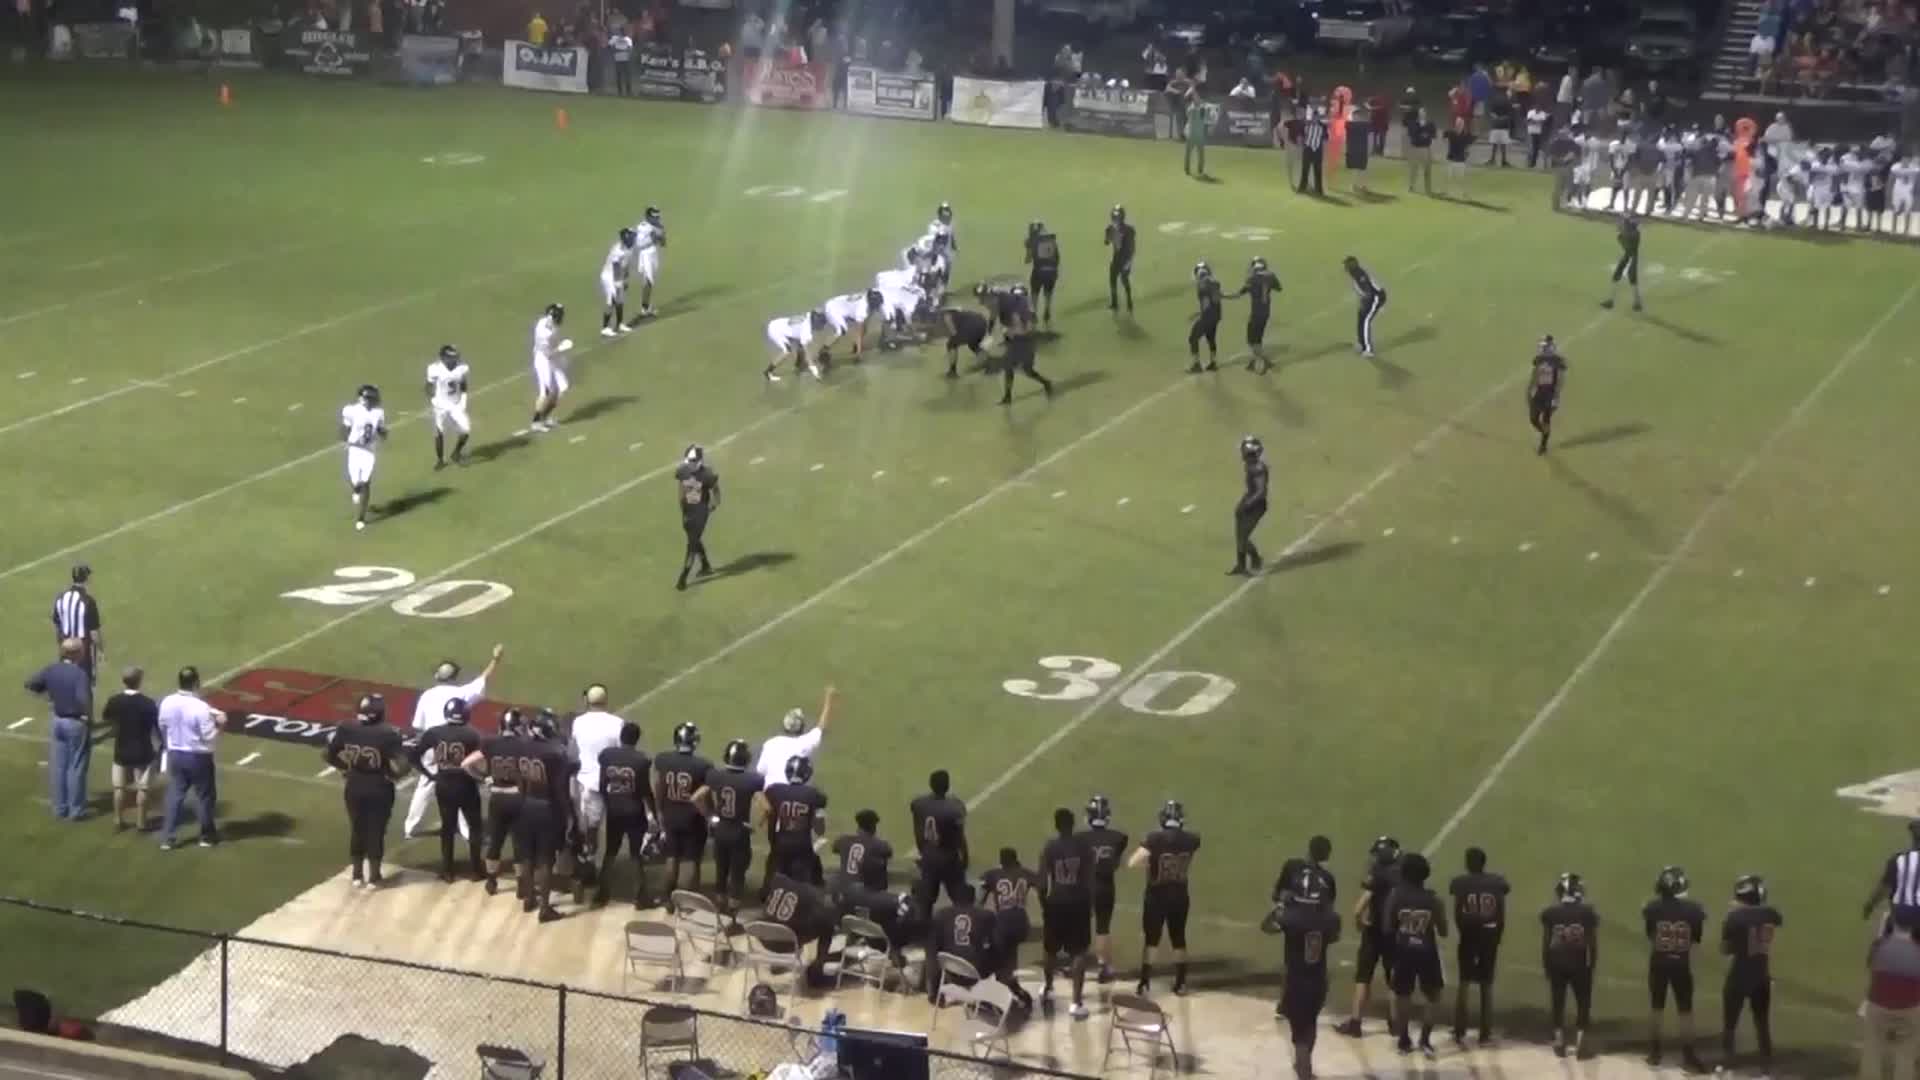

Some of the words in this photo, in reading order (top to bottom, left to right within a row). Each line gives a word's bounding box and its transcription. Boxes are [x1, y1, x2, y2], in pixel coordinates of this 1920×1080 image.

[280, 566, 513, 618] 20
[1003, 655, 1236, 716] 30
[665, 771, 693, 800] 12
[767, 888, 799, 921] 16
[953, 914, 972, 946] 2
